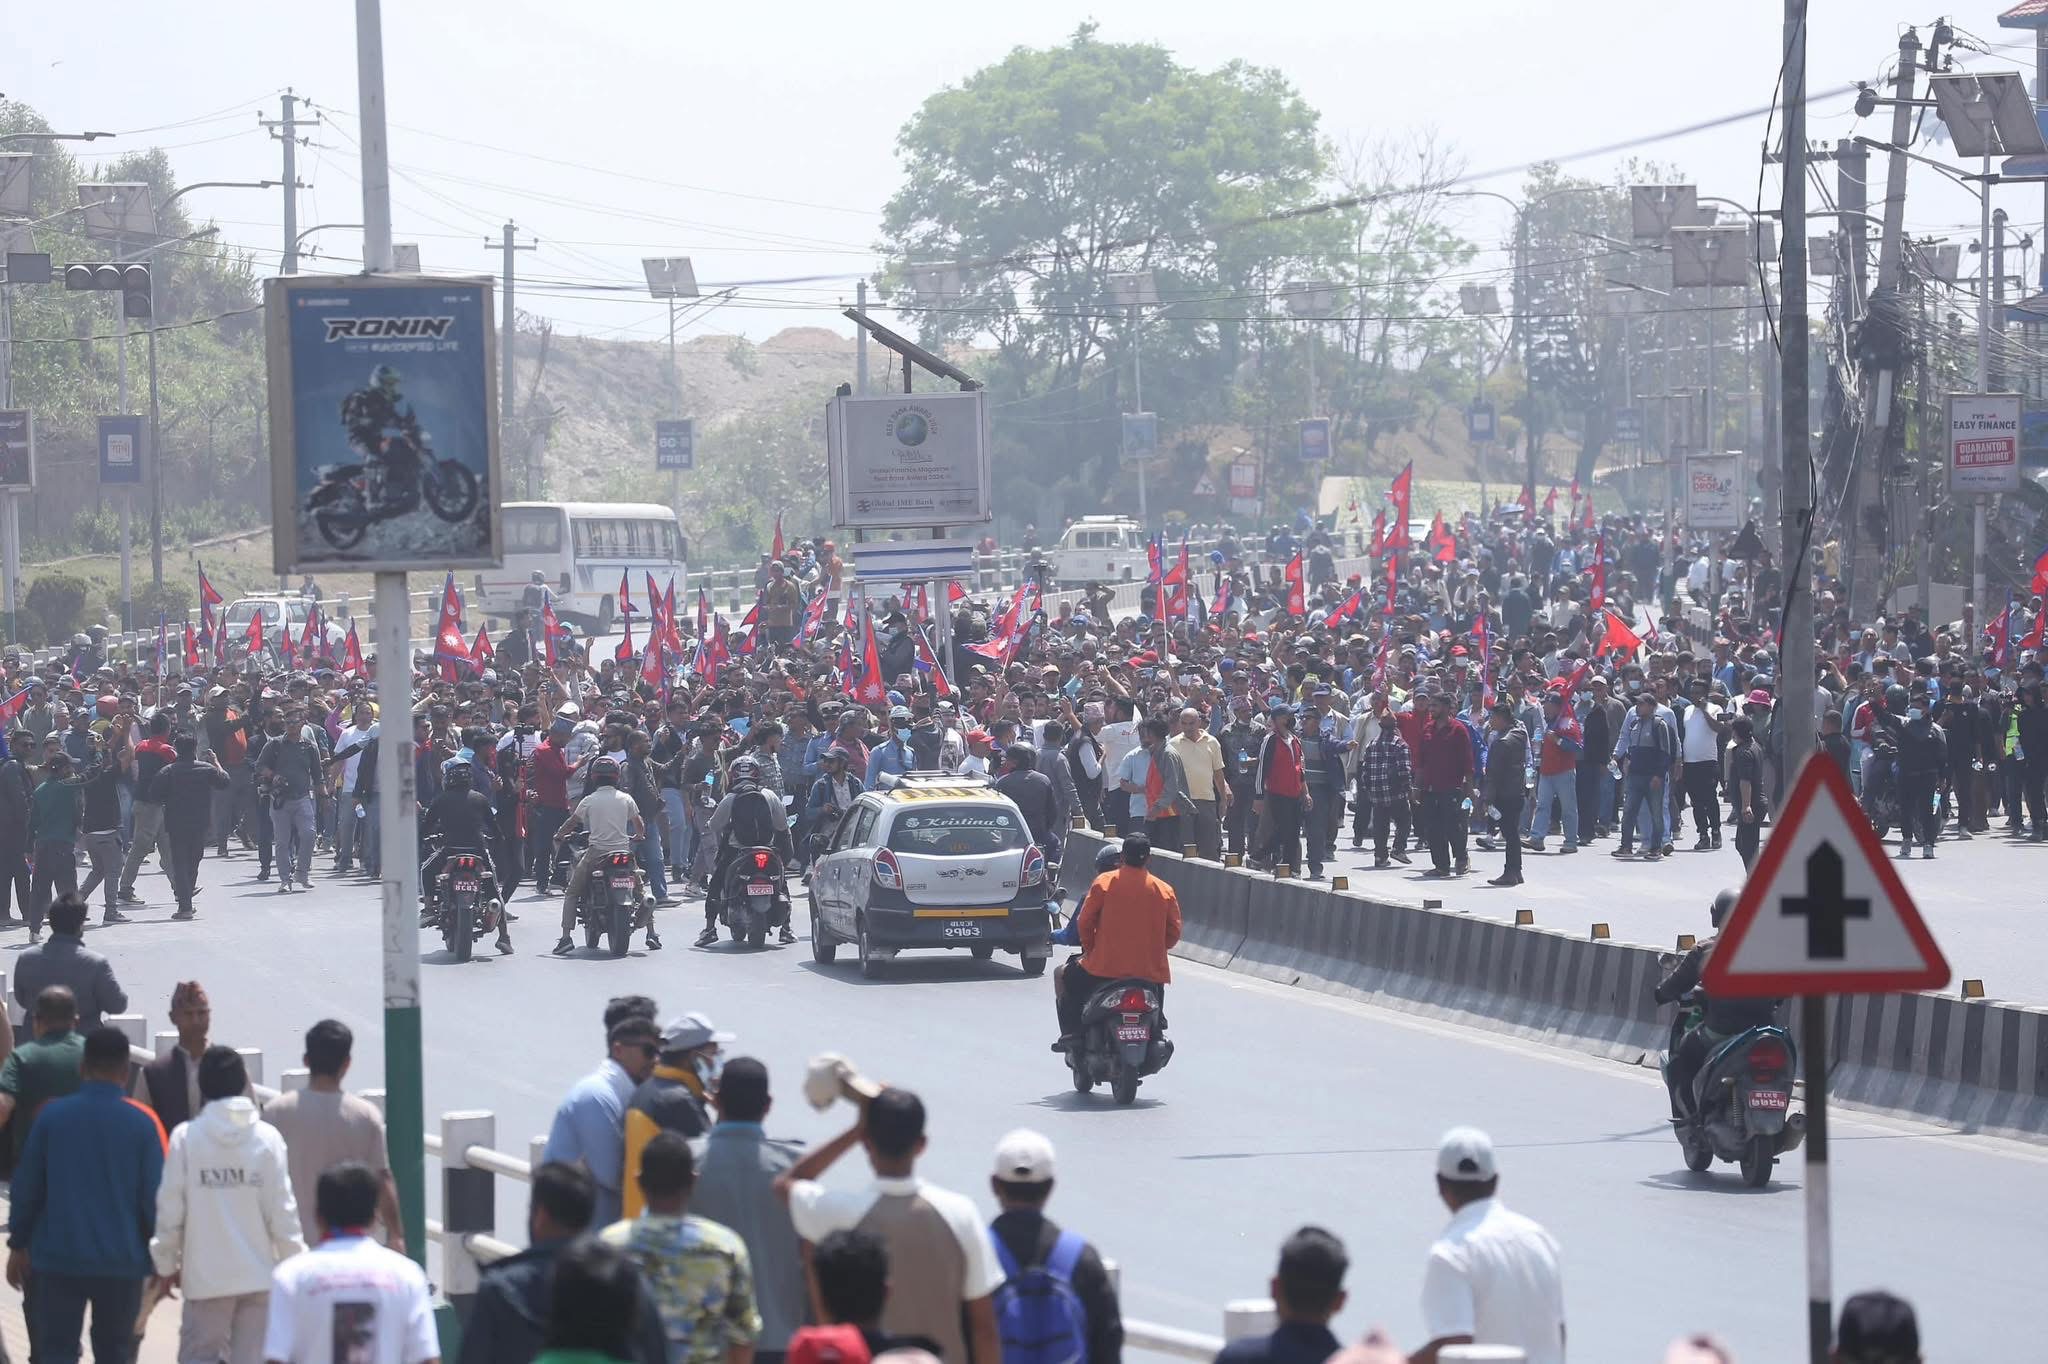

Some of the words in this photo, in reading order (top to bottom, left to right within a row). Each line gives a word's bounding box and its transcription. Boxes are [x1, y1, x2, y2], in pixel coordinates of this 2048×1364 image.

[322, 316, 455, 343] RONIN
[1953, 421, 1976, 430] EASY
[1978, 420, 2017, 430] FINANCE
[1960, 441, 2008, 455] GUARANTOR
[924, 817, 996, 827] Kristina
